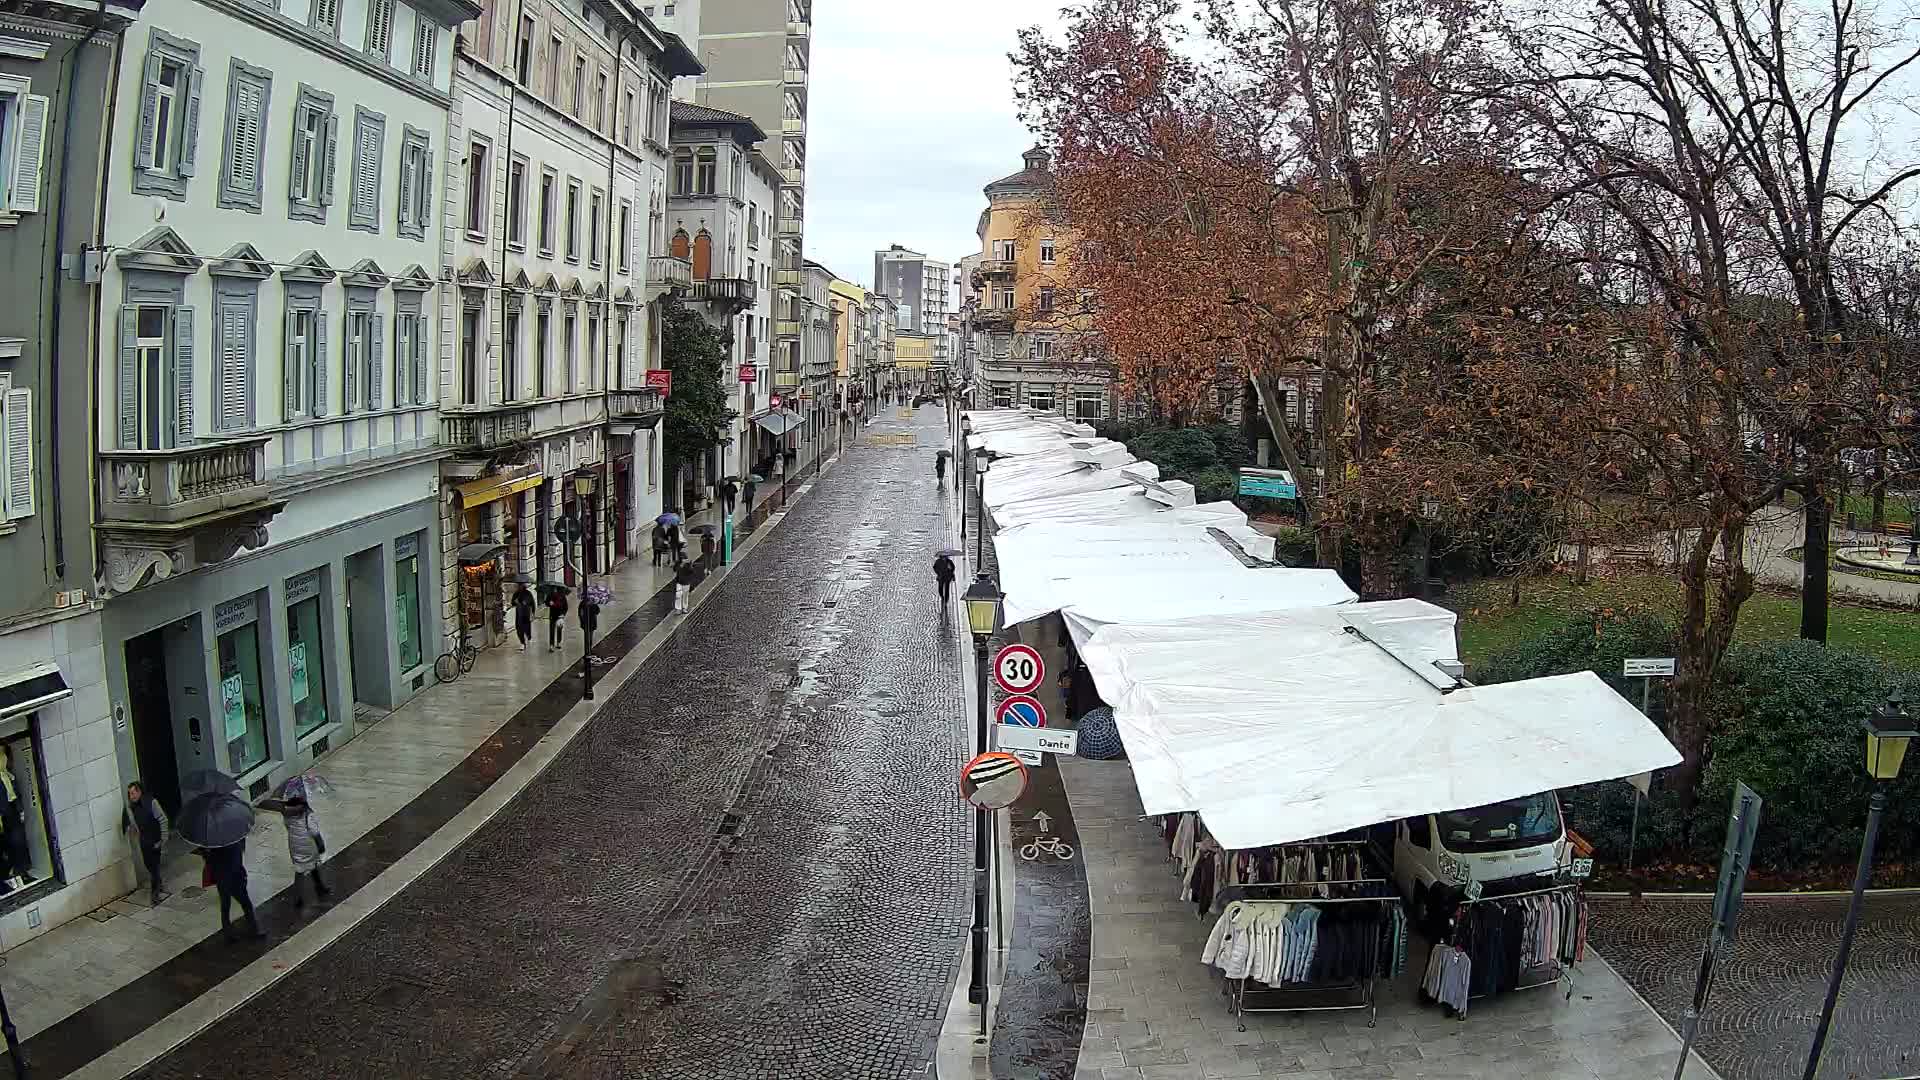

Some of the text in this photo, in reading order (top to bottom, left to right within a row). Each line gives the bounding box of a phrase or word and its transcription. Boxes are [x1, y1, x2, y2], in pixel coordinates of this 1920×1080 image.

[1006, 659, 1033, 681] 30
[223, 677, 241, 700] 130
[1039, 738, 1070, 750] Dante
